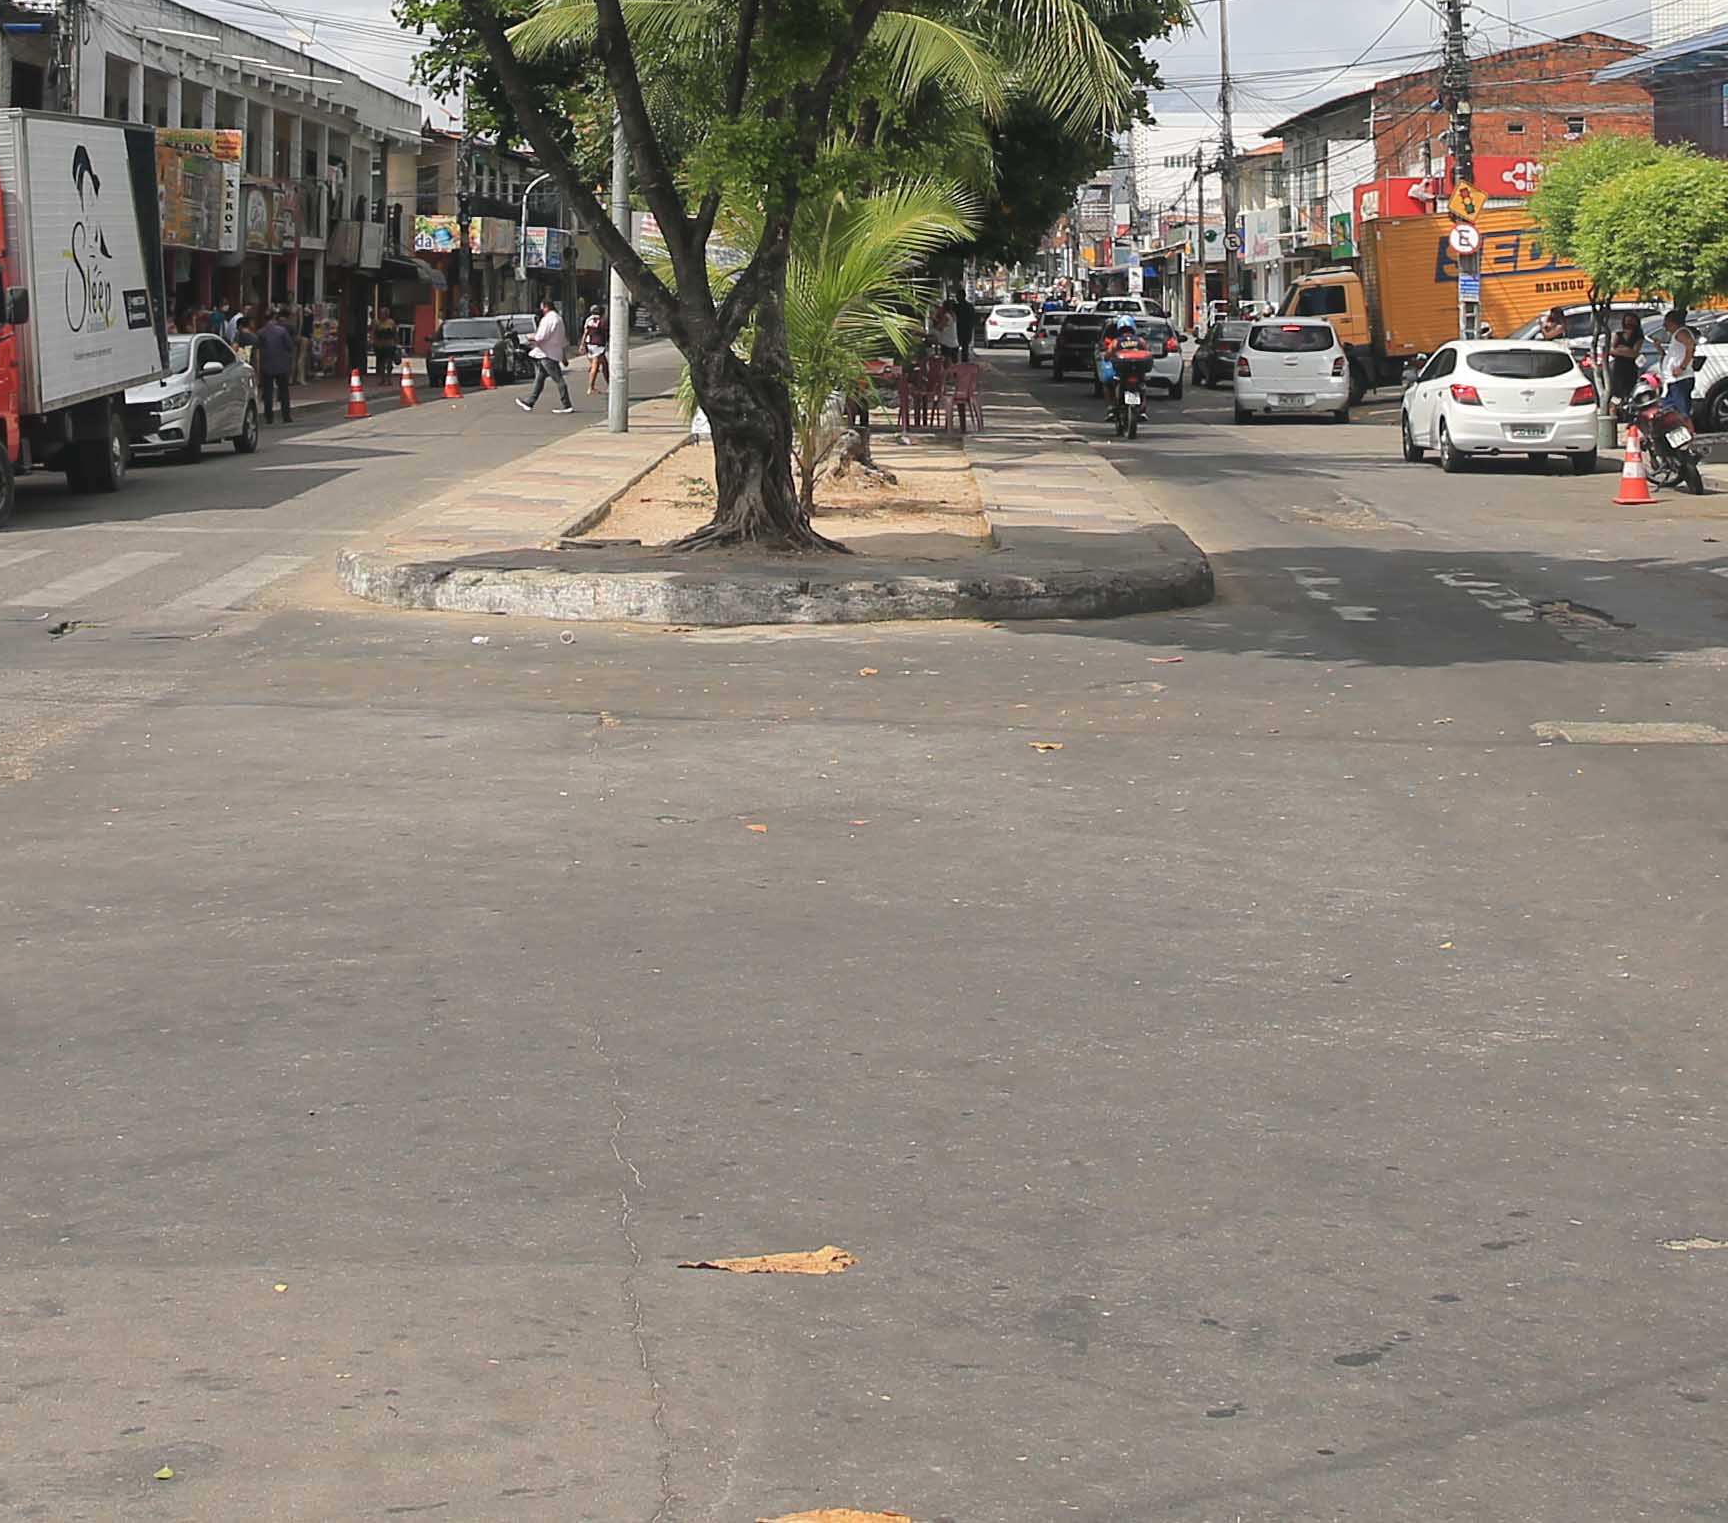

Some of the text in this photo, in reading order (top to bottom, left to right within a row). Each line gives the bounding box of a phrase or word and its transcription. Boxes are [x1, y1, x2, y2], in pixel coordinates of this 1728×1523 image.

[223, 179, 235, 235] XEROX
[1458, 229, 1472, 248] E
[65, 221, 112, 333] Sleep
[1535, 280, 1585, 294] MANDOU
